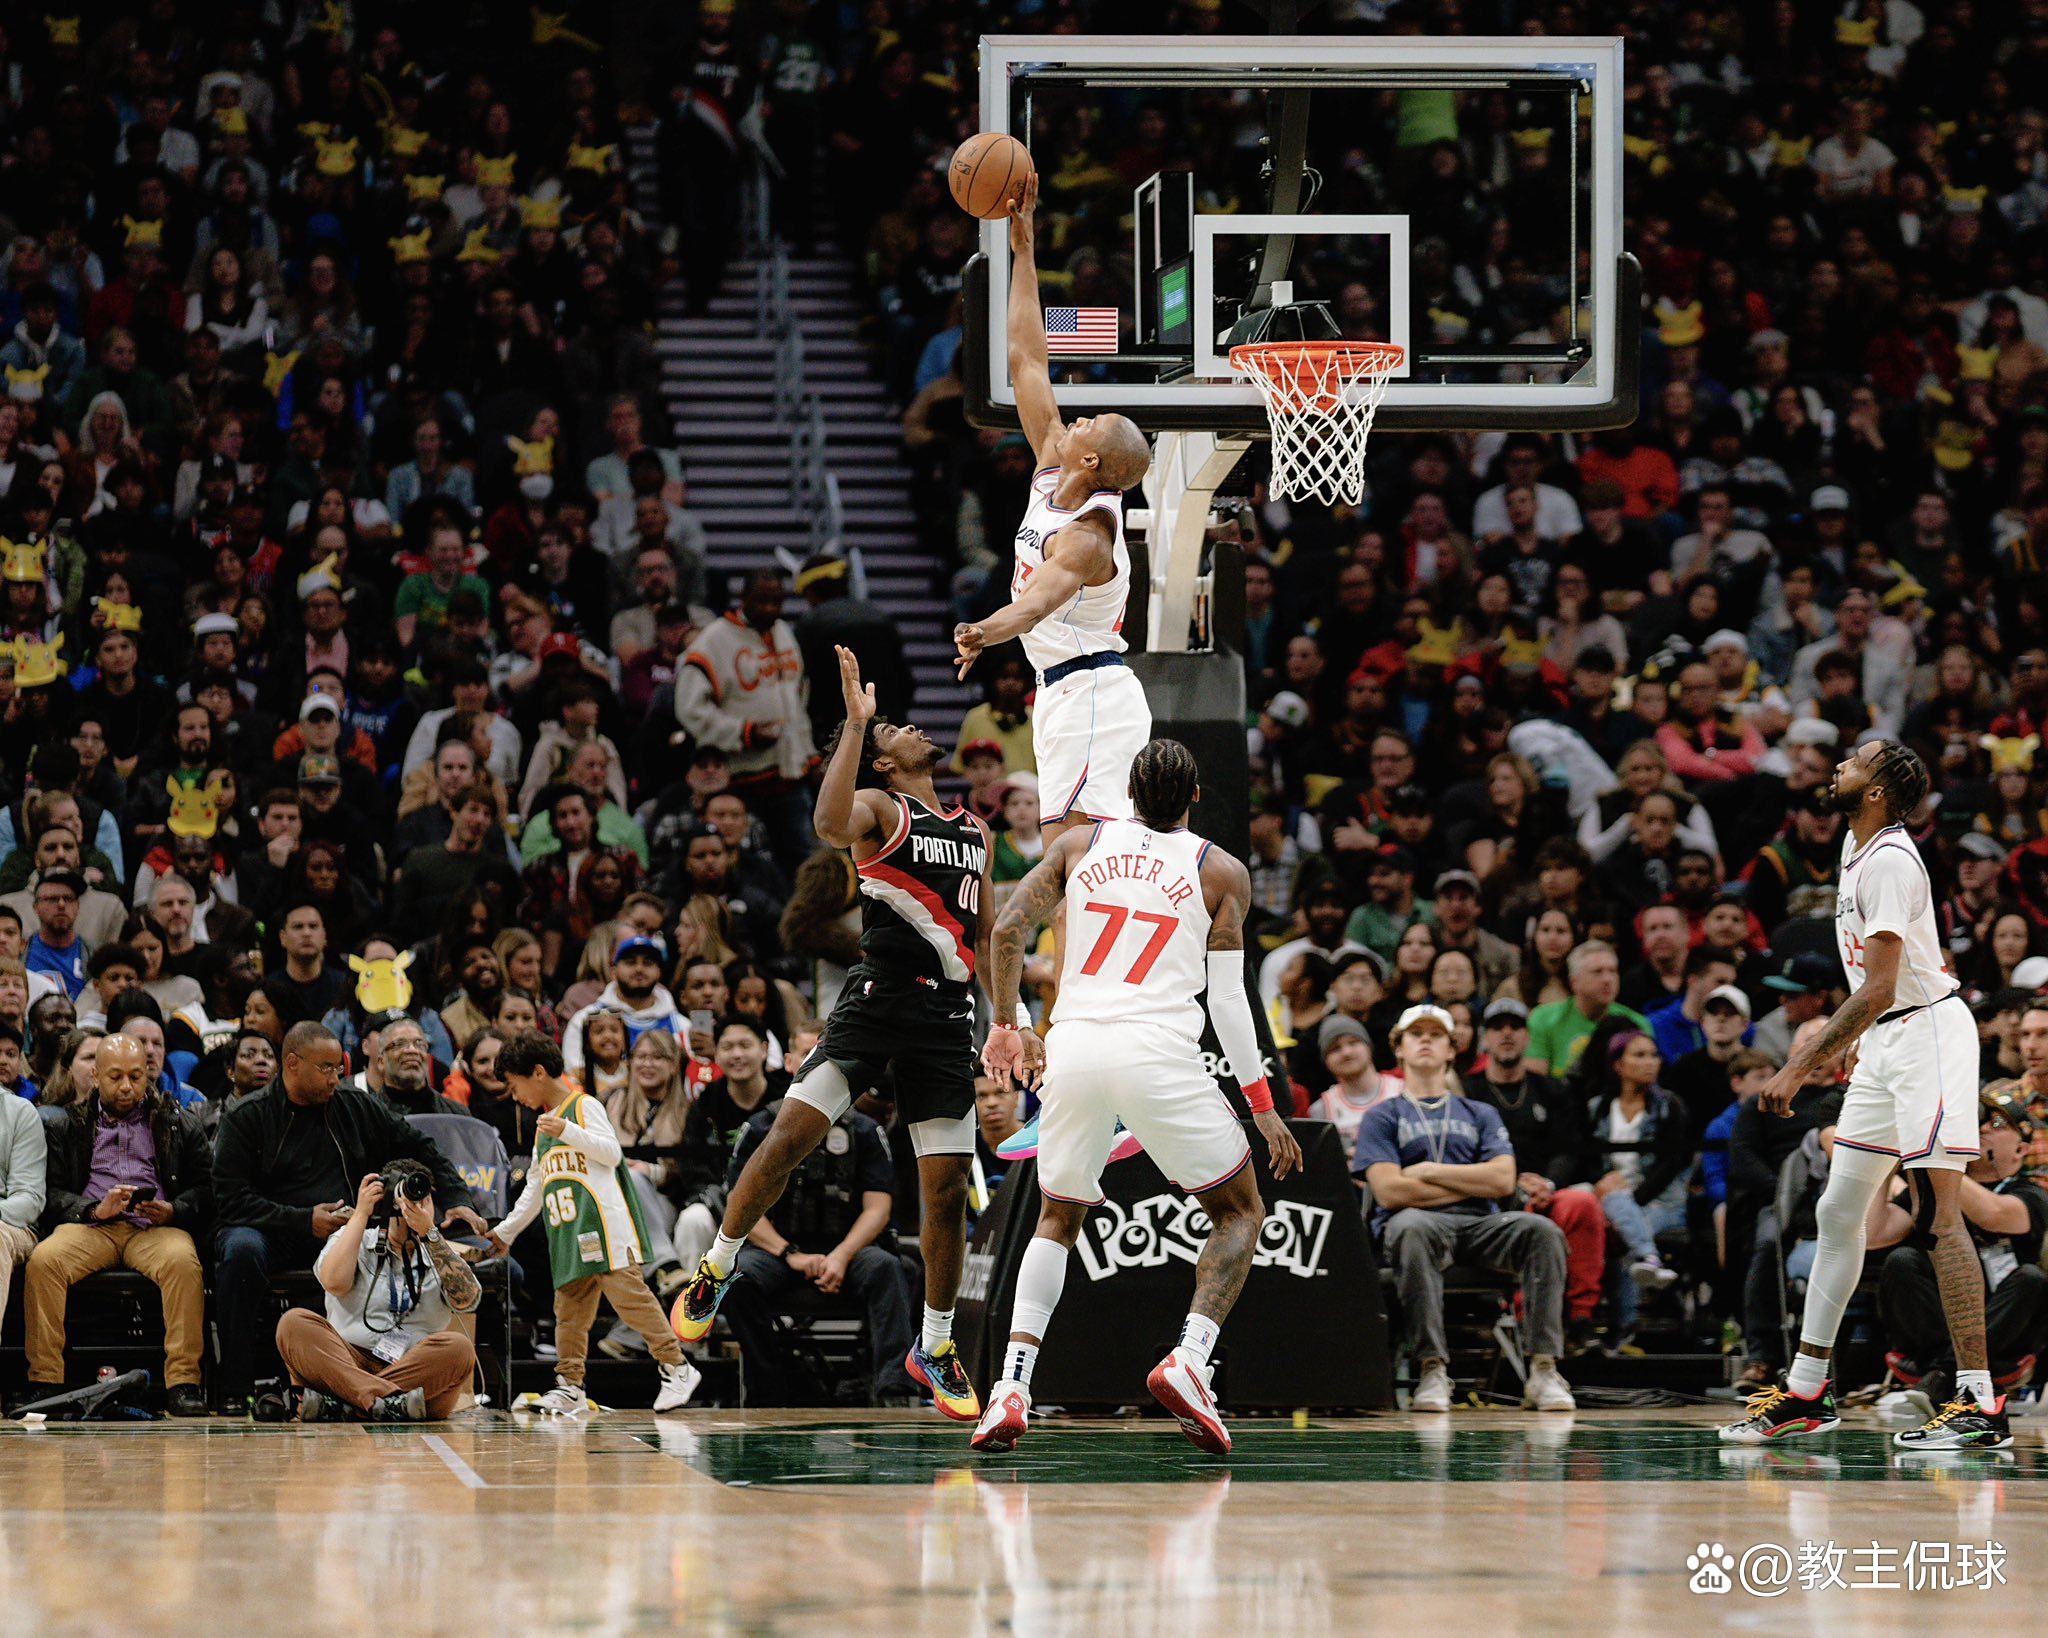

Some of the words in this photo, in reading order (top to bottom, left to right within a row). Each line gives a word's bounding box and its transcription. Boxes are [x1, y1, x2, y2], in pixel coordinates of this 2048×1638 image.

[910, 835, 986, 876] PORTLAND
[1077, 854, 1164, 893] PORTER
[957, 874, 980, 915] 00
[1080, 902, 1180, 985] 77
[1200, 1049, 1274, 1077] Bok
[545, 1186, 577, 1227] 35
